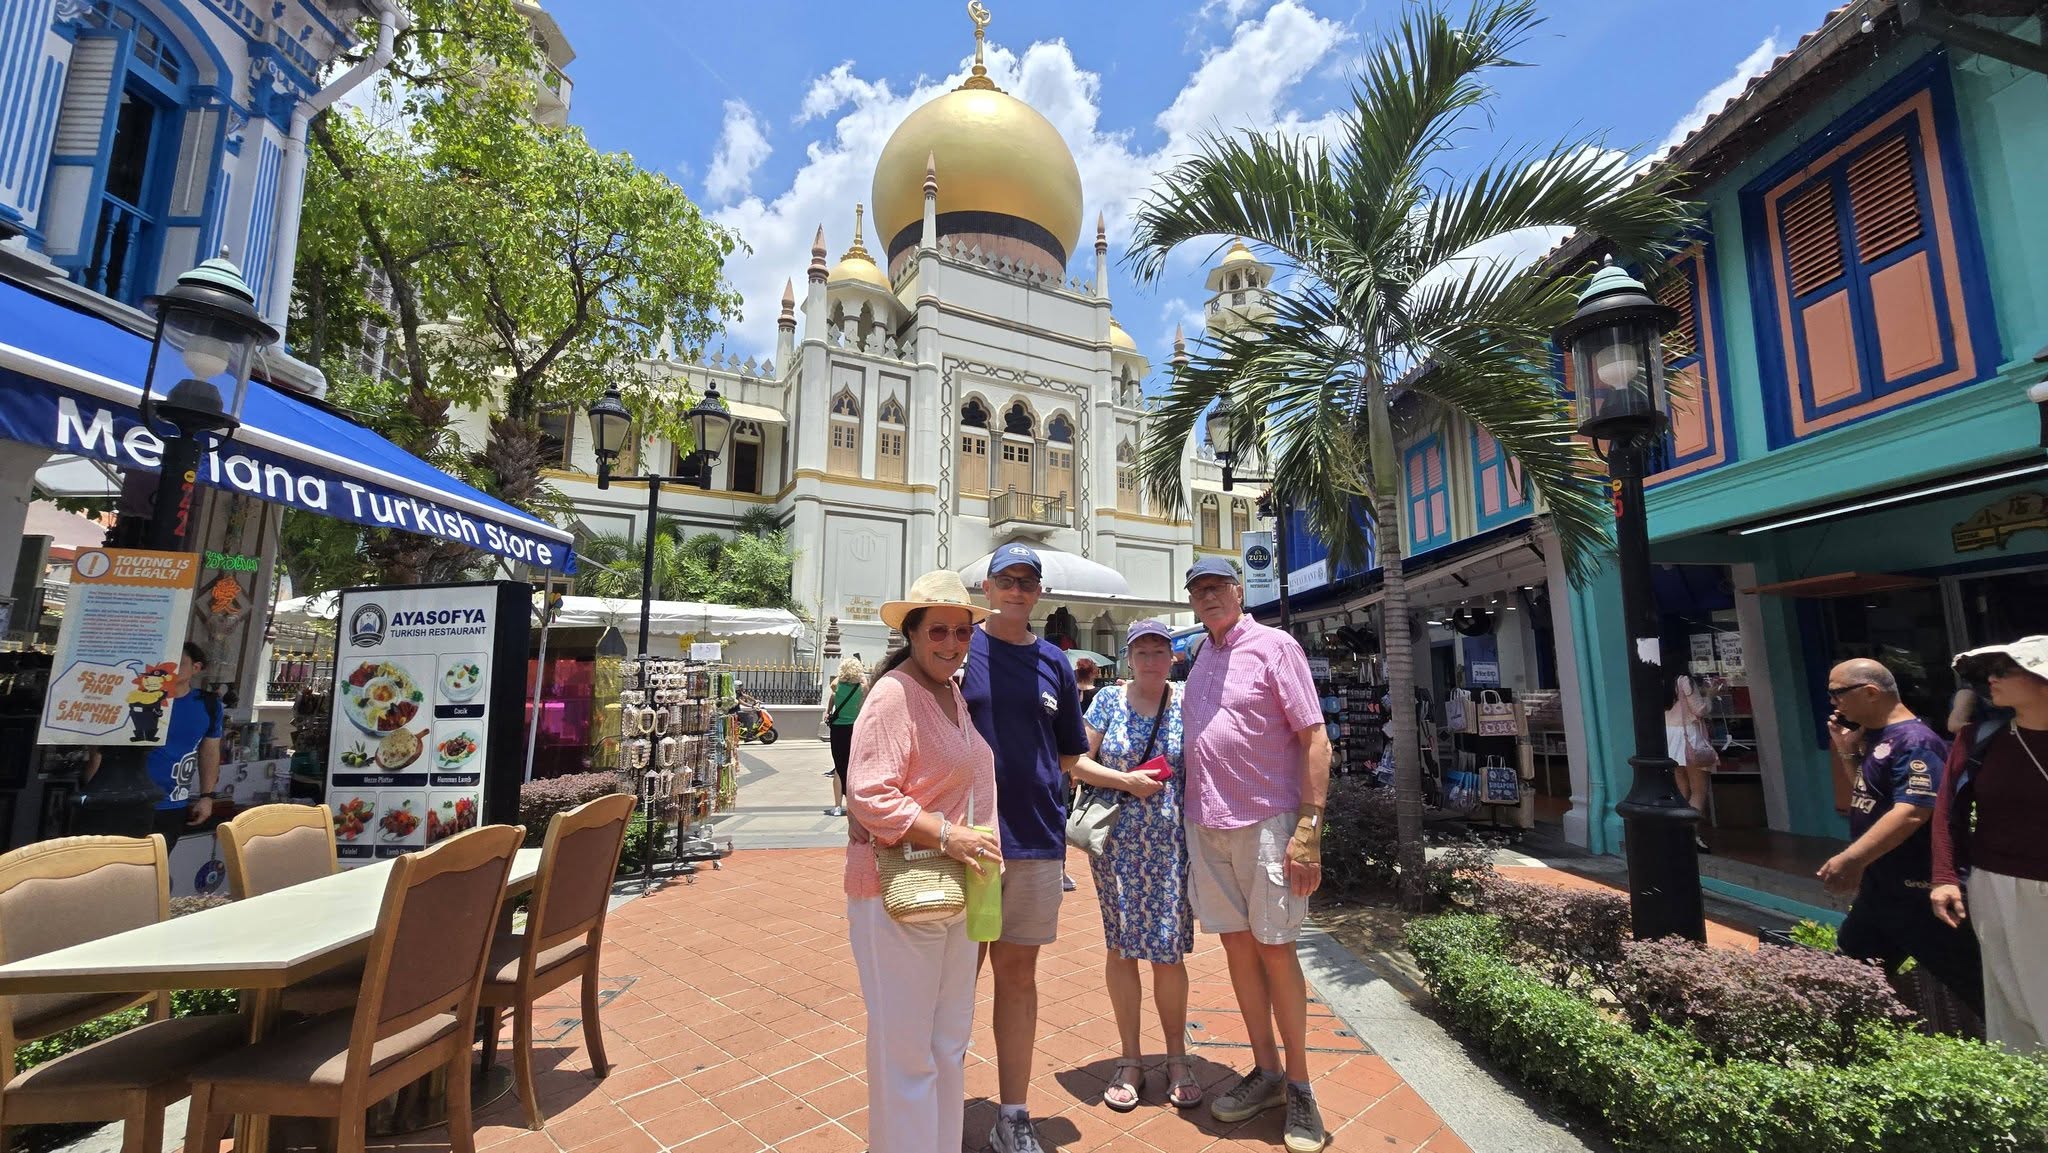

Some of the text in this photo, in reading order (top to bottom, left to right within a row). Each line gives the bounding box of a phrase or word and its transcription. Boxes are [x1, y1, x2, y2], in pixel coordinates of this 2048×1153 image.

[57, 396, 328, 510] Meiana
[342, 481, 480, 544] Turkish
[115, 555, 190, 570] TOUTING IS
[113, 566, 180, 580] ILLEGAL?!
[390, 608, 487, 627] AYASOFYA
[390, 626, 487, 638] TURKISH RESTAURANT
[81, 681, 114, 696] FINE
[58, 700, 123, 715] 6 MONTHS
[56, 710, 119, 725] JAIL TIME
[458, 775, 472, 783] Lamb
[386, 848, 399, 856] Lamb
